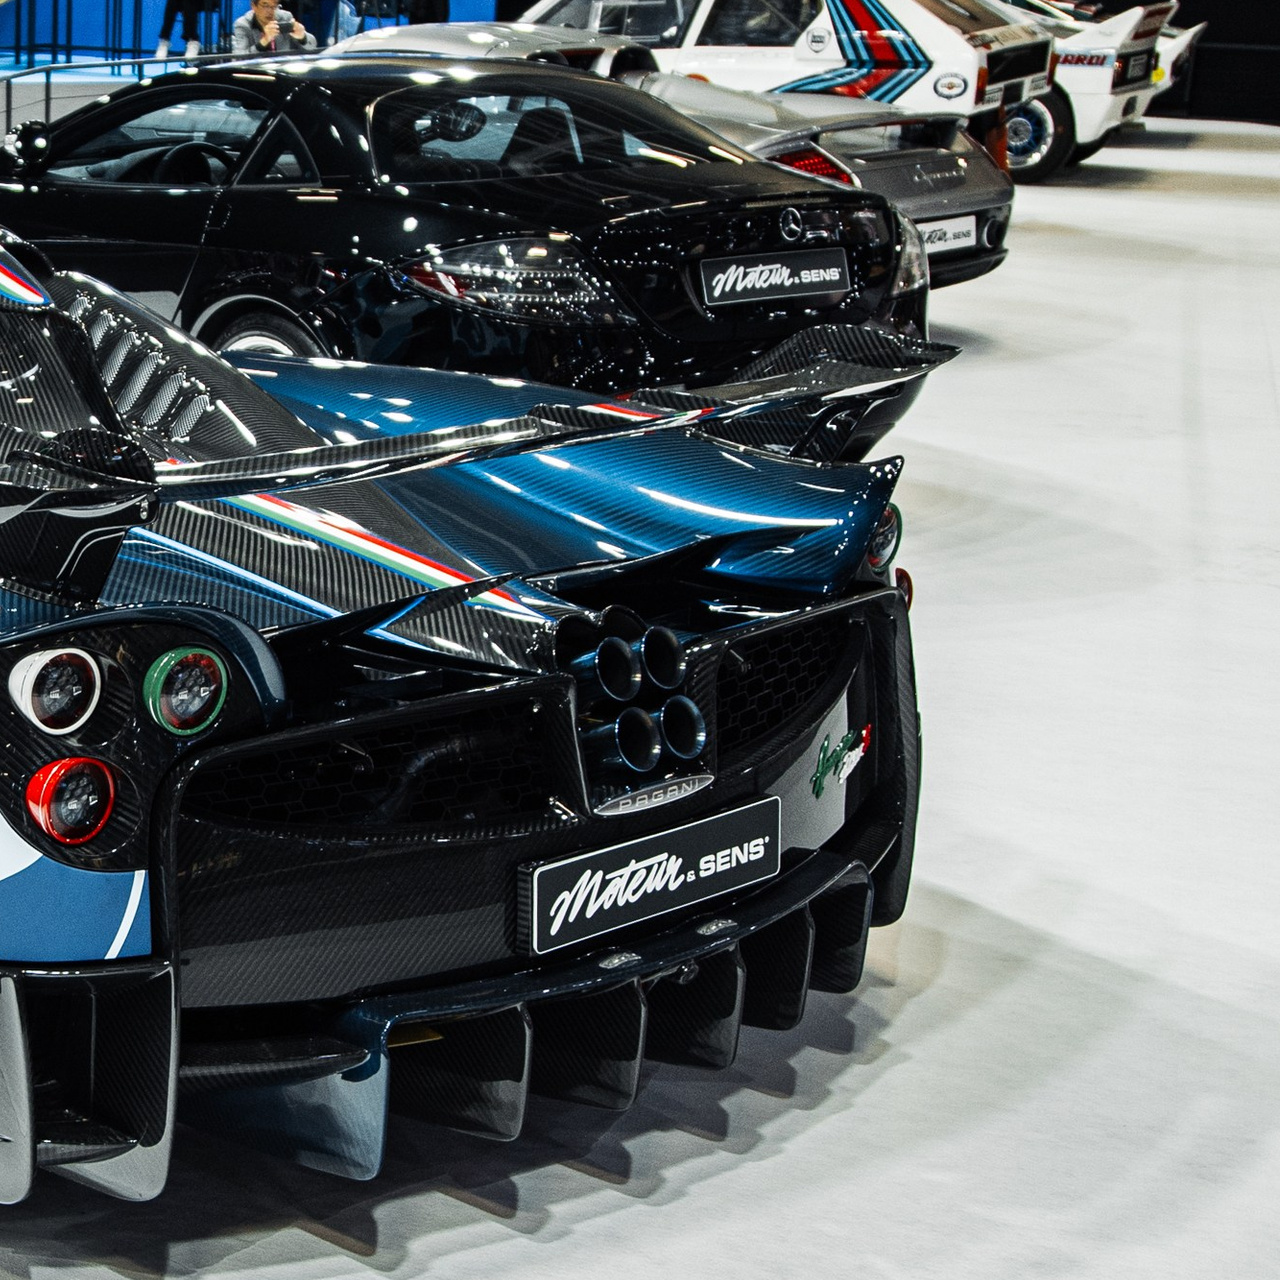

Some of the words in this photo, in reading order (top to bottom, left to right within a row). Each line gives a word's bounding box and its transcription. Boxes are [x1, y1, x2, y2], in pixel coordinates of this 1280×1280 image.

[712, 263, 793, 297] Moteur
[618, 779, 699, 812] PAGANI
[549, 852, 685, 936] Moteur
[686, 870, 696, 882] &
